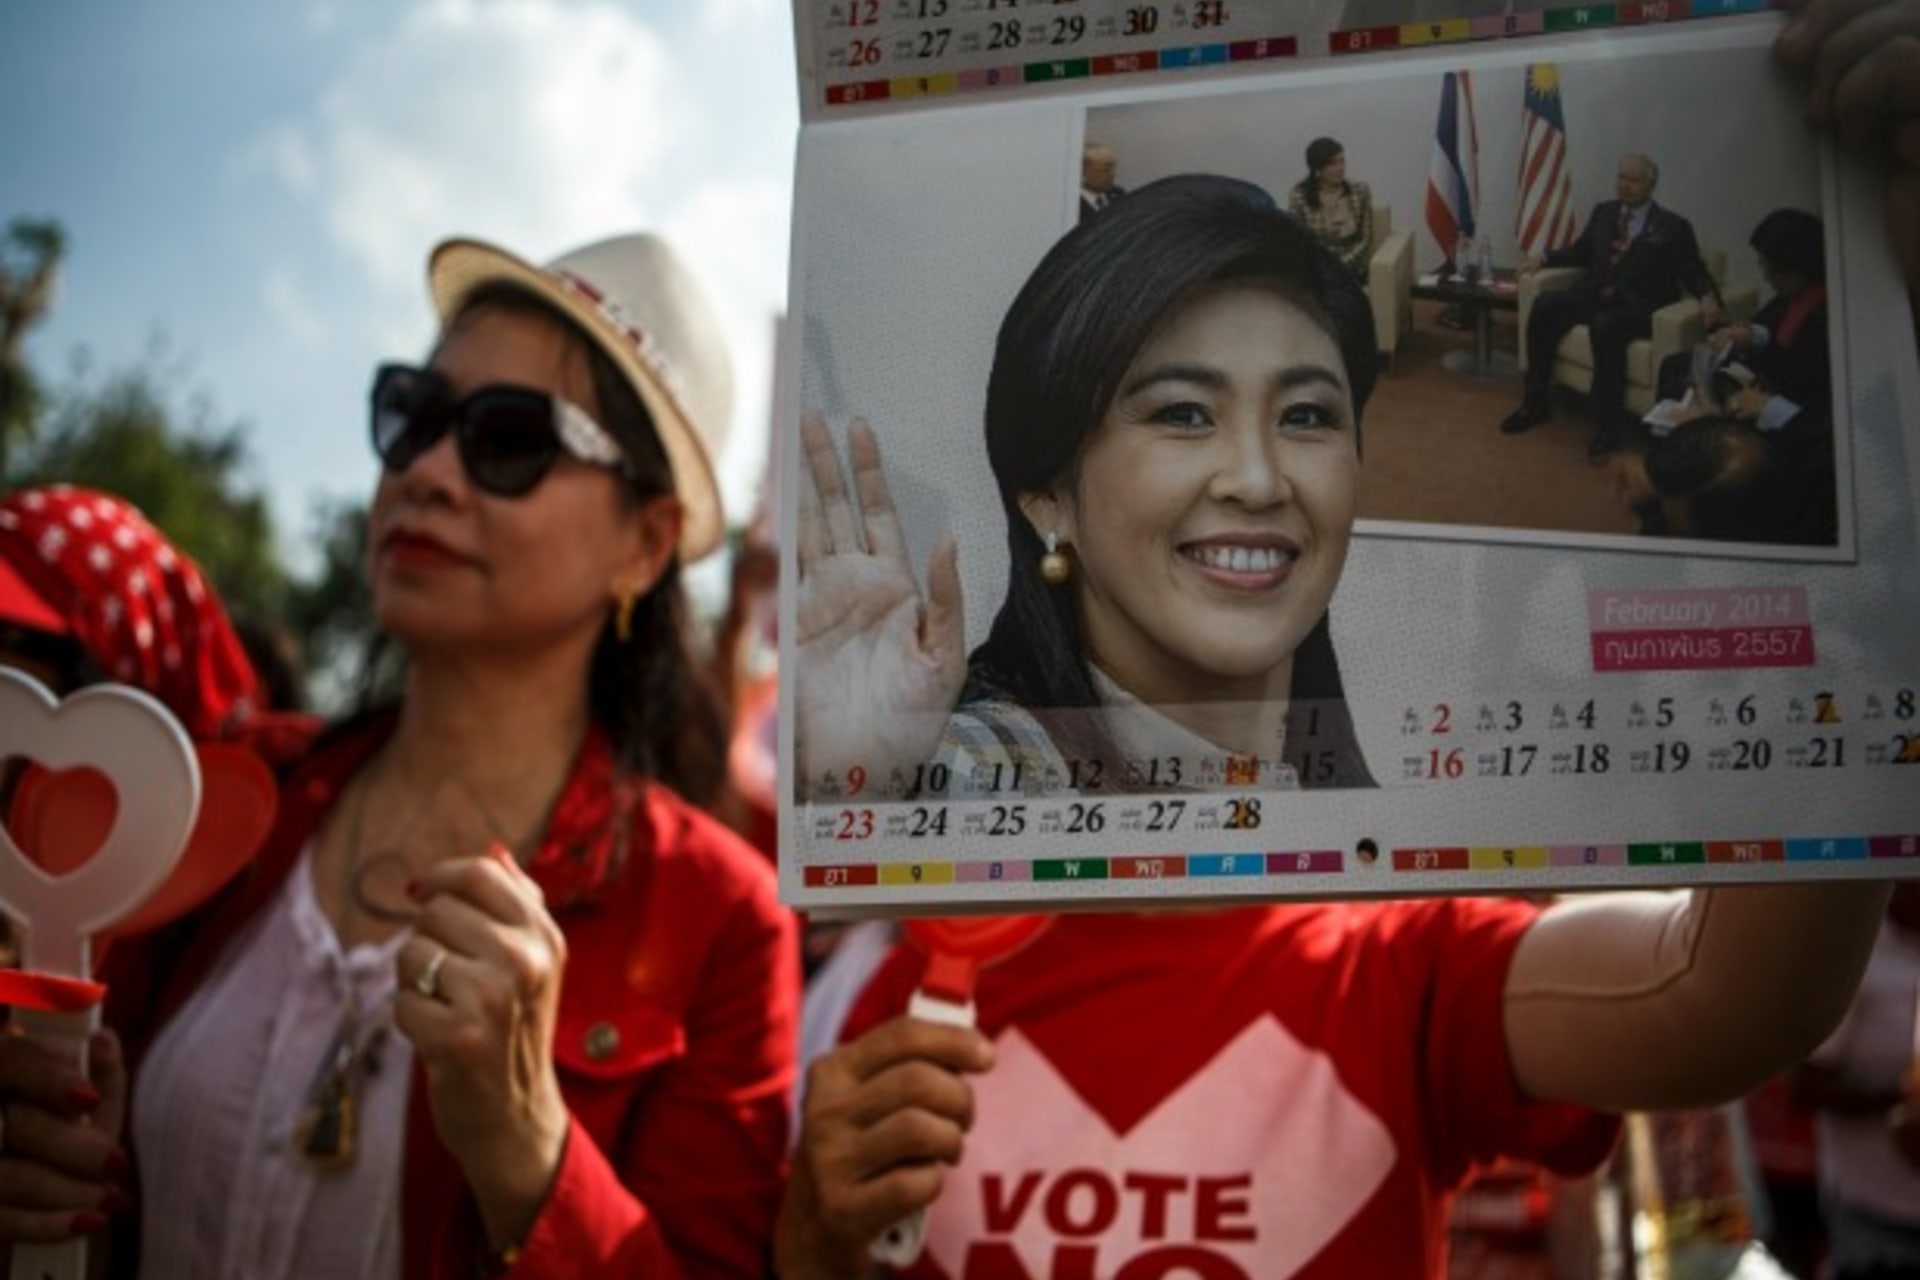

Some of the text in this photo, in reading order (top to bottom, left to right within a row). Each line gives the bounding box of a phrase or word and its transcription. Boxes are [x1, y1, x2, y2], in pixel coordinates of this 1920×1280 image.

[848, 0, 880, 27] 12
[848, 38, 881, 67] 26
[917, 28, 951, 58] 27
[987, 19, 1022, 50] 28
[1051, 15, 1086, 45] 29
[1122, 6, 1159, 36] 30
[1604, 593, 1791, 627] February 2014
[1732, 629, 1803, 656] 2557
[1308, 707, 1319, 736] 1
[1431, 703, 1450, 733] 2
[1504, 700, 1523, 732] 3
[1576, 699, 1596, 729] 4
[1656, 697, 1675, 727] 5
[1737, 694, 1756, 725] 6
[1895, 689, 1915, 720] 8
[846, 765, 866, 796] 9
[913, 763, 949, 793] 10
[988, 762, 1022, 791] 11
[1067, 758, 1103, 789] 12
[1147, 756, 1182, 786] 13
[1302, 752, 1335, 781] 15
[1428, 747, 1464, 780] 16
[1500, 744, 1538, 776] 17
[1574, 744, 1610, 774] 18
[1653, 741, 1691, 773] 19
[1732, 738, 1772, 771] 20
[1809, 736, 1846, 768] 21
[837, 809, 874, 840] 23
[910, 807, 948, 837] 24
[988, 806, 1026, 836] 25
[1066, 803, 1105, 834] 26
[1145, 801, 1186, 832] 27
[1223, 798, 1262, 830] 28
[979, 1167, 1258, 1242] VOTE
